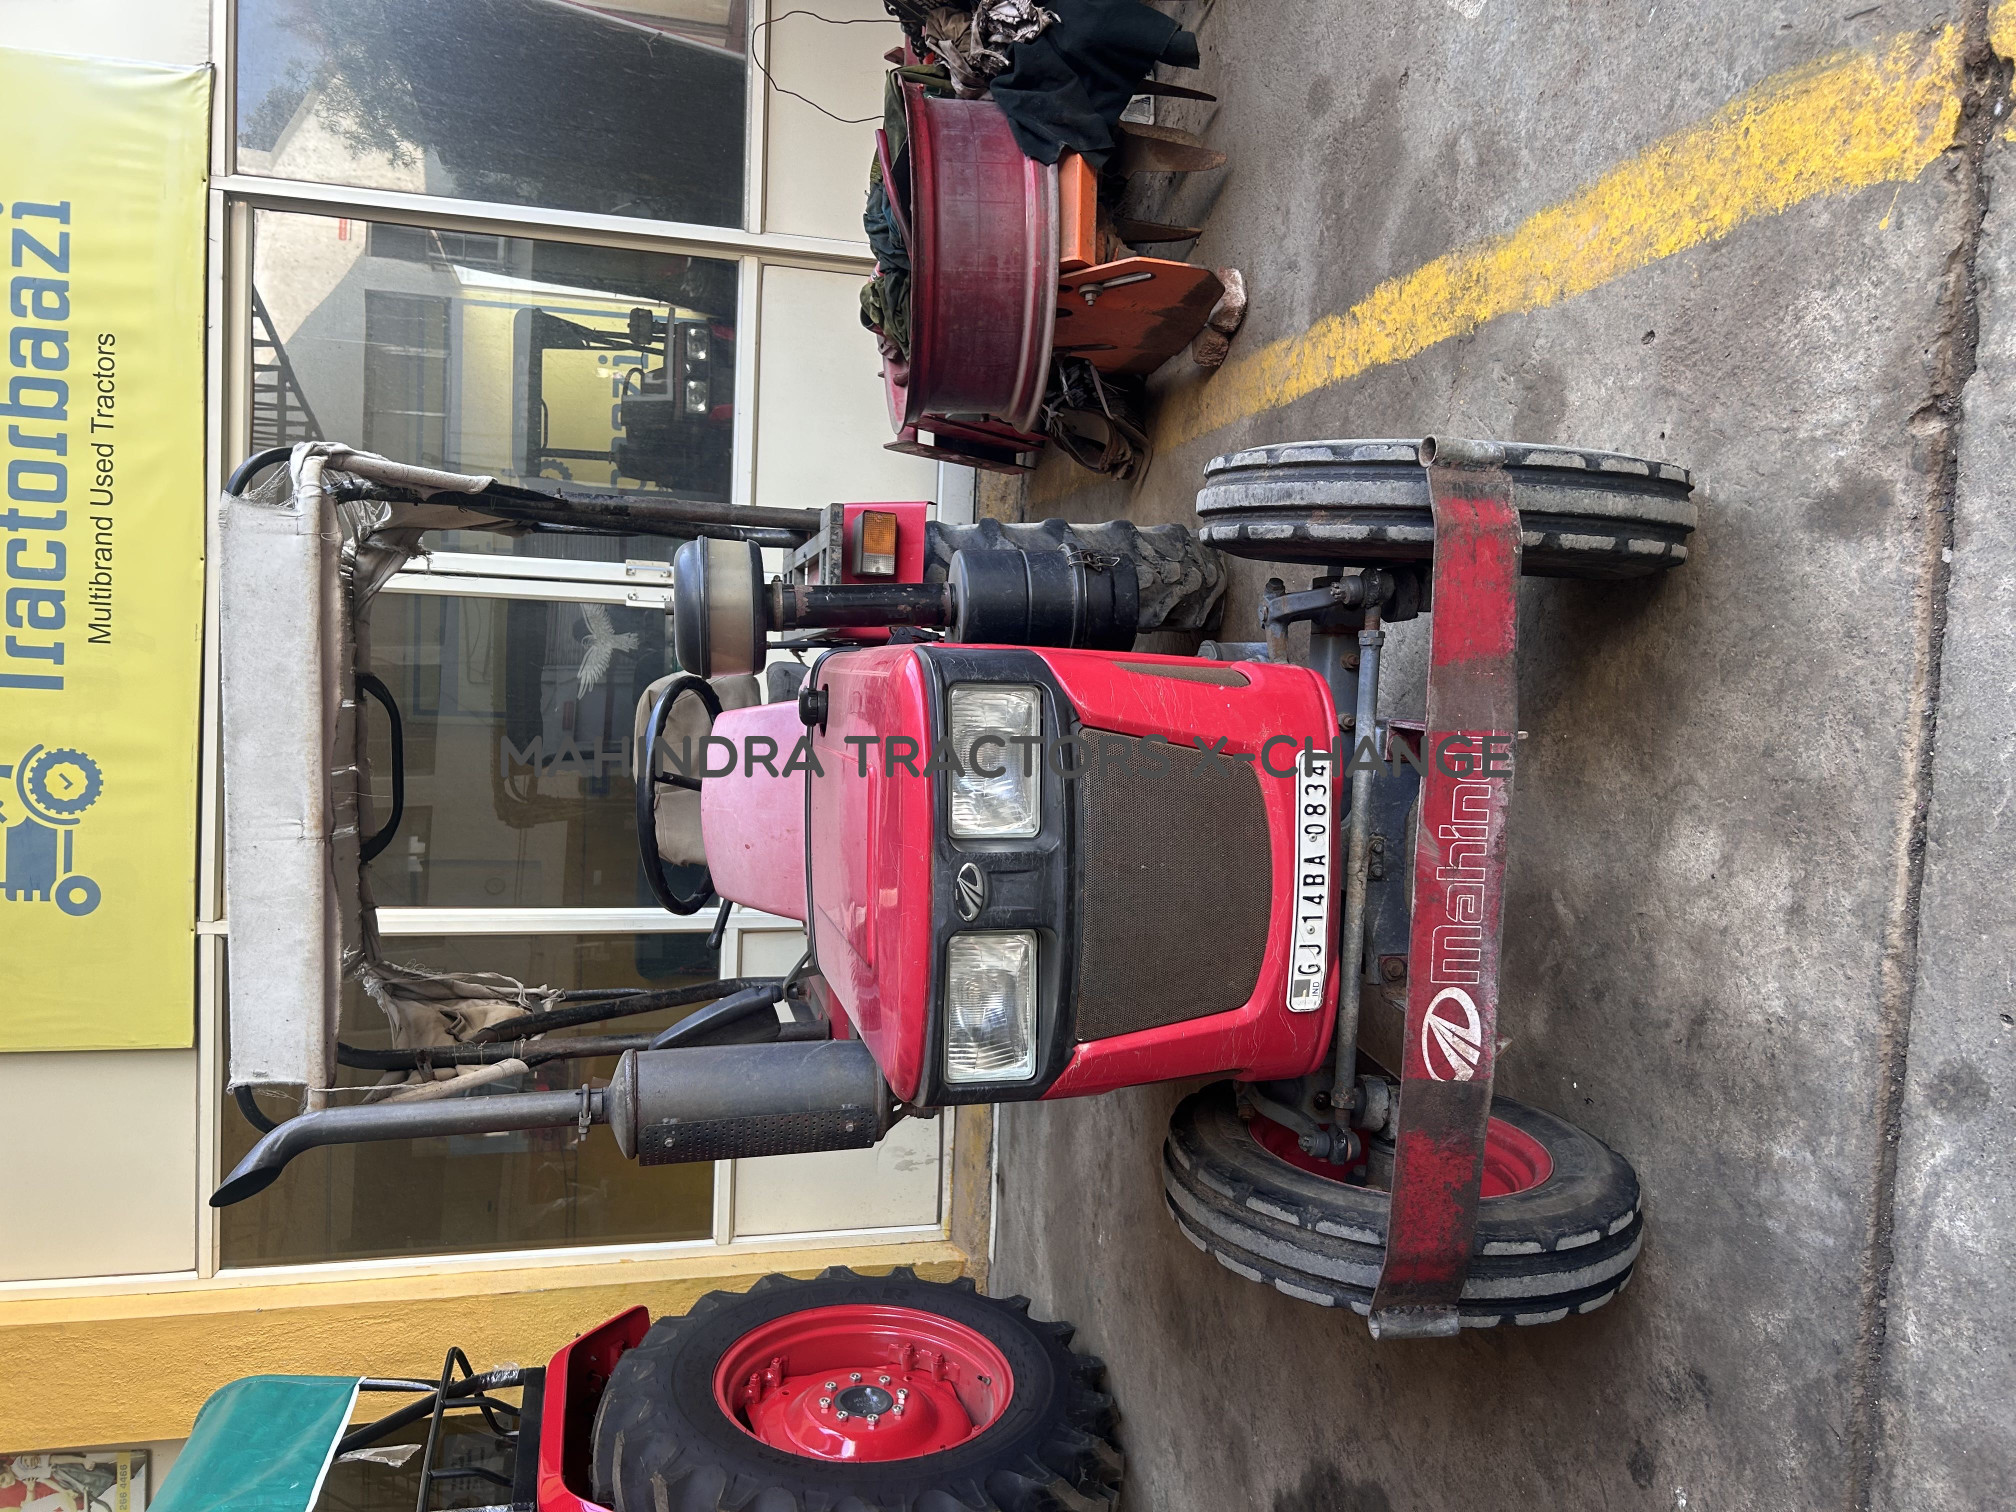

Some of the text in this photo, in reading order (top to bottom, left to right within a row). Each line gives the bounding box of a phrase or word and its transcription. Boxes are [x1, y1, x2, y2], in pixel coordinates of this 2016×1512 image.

[88, 333, 116, 644] Multibrand Used Tractors
[1312, 982, 1320, 997] IND
